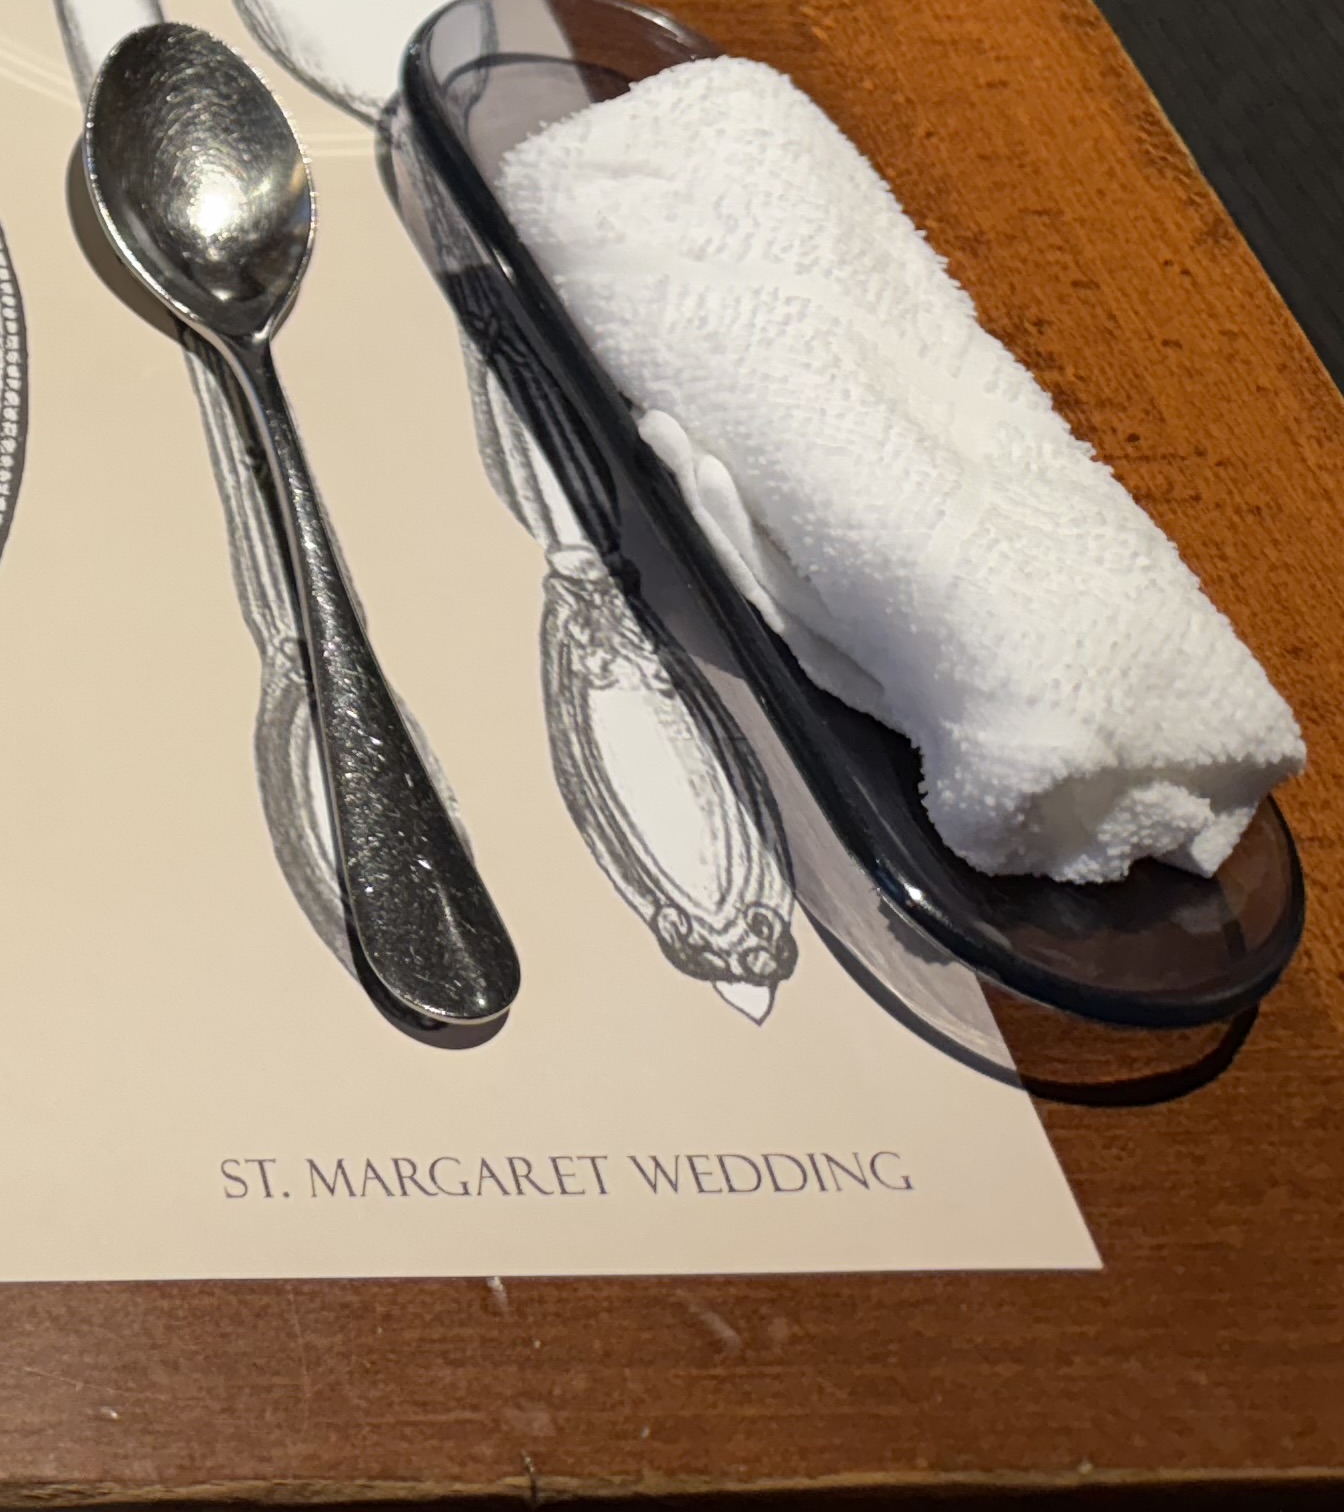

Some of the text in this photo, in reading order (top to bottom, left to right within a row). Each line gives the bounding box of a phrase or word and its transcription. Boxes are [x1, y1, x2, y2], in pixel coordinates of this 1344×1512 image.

[220, 1150, 915, 1199] ST. MARGARET WEDDING
